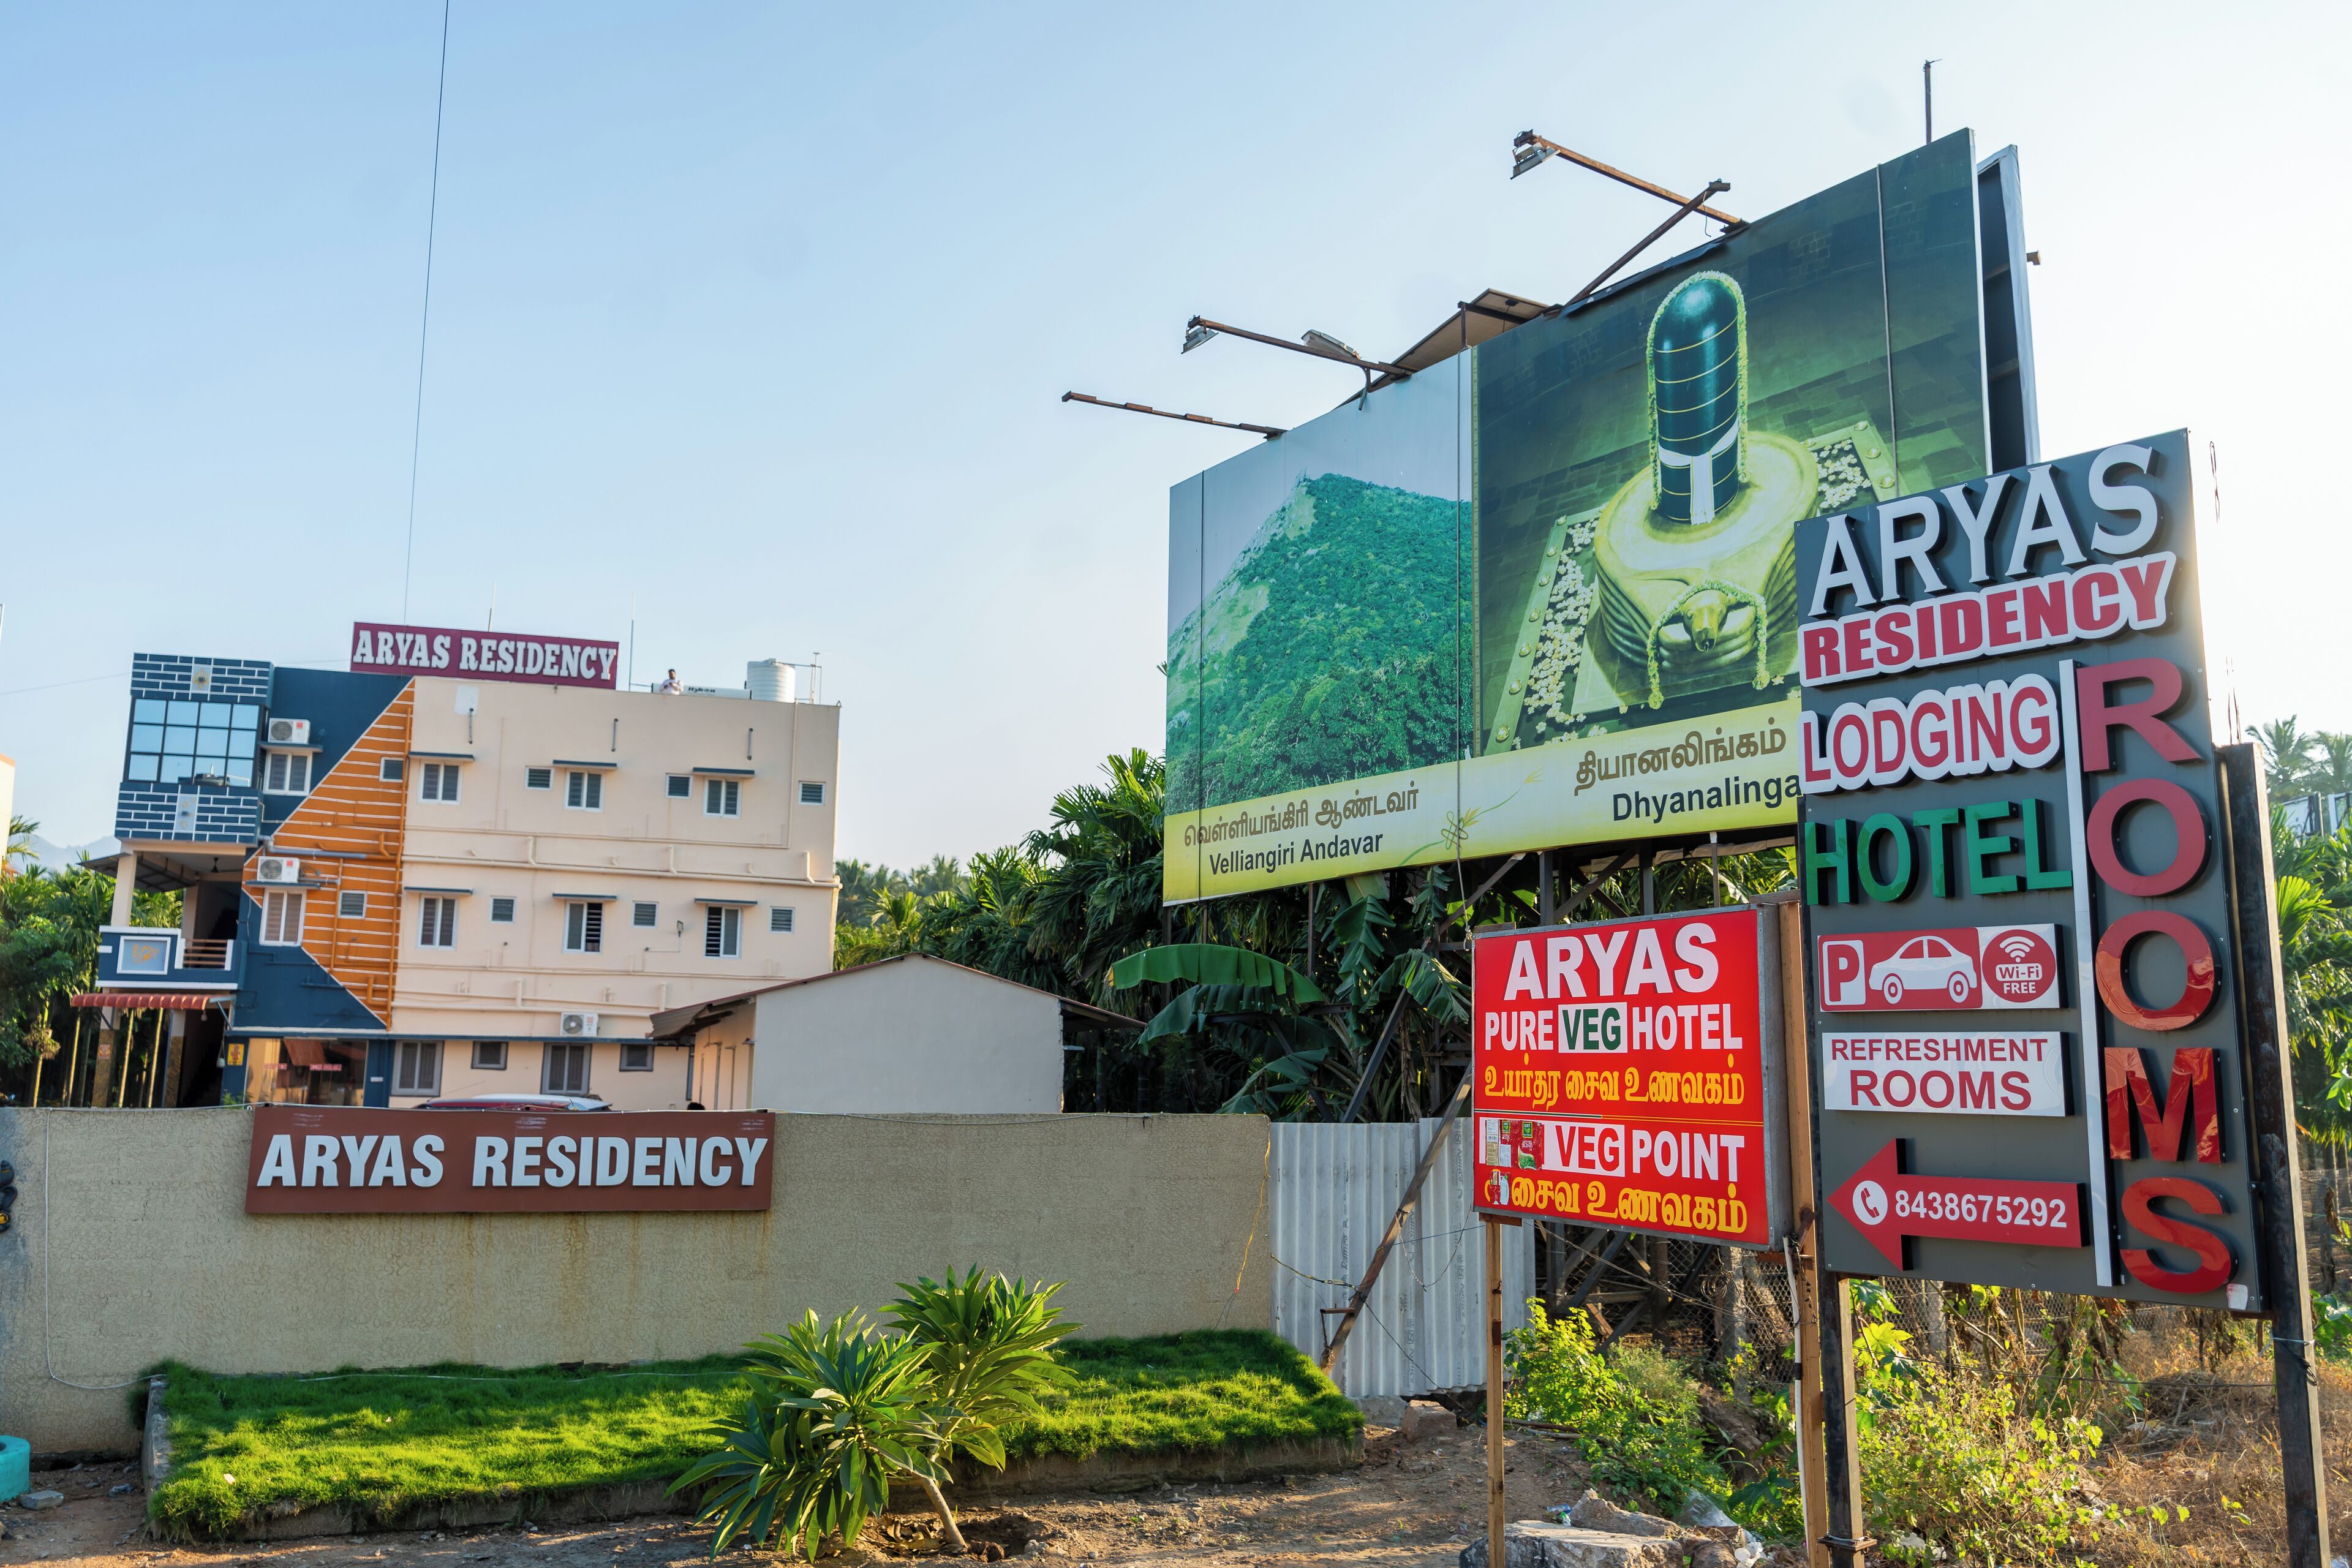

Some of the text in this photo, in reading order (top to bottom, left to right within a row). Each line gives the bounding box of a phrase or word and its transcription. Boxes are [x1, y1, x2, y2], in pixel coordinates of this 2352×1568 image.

[1809, 443, 2157, 618] ARYAS
[1803, 559, 2169, 681] RESIDENCY
[353, 630, 617, 680] ARYAS RESIDENCY
[1574, 717, 1787, 796] தியானலிங்கம்
[1803, 685, 2052, 783] LODGING
[1613, 774, 1803, 824] Dhyanalinga
[1210, 833, 1384, 875] Velliangiri Andavar
[1805, 798, 2073, 905] HOTEL
[1503, 922, 1719, 1001] ARYAS
[1998, 965, 2040, 979] Wi-Fi
[2076, 657, 2239, 1294] ROOMS
[2003, 982, 2037, 995] FREE
[1485, 1003, 1743, 1051] PURE VEG HOTEL
[1831, 1038, 2048, 1062] REFRESHMENT
[1565, 1070, 1620, 1102] சைவ
[1624, 1053, 1745, 1106] உணவகம்
[1850, 1069, 2032, 1111] ROOMS
[257, 1134, 769, 1188] ARYAS RESIDENCY
[1555, 1125, 1620, 1172] VEG
[1632, 1129, 1745, 1183] POINT
[1894, 1189, 2067, 1229] 8438675292
